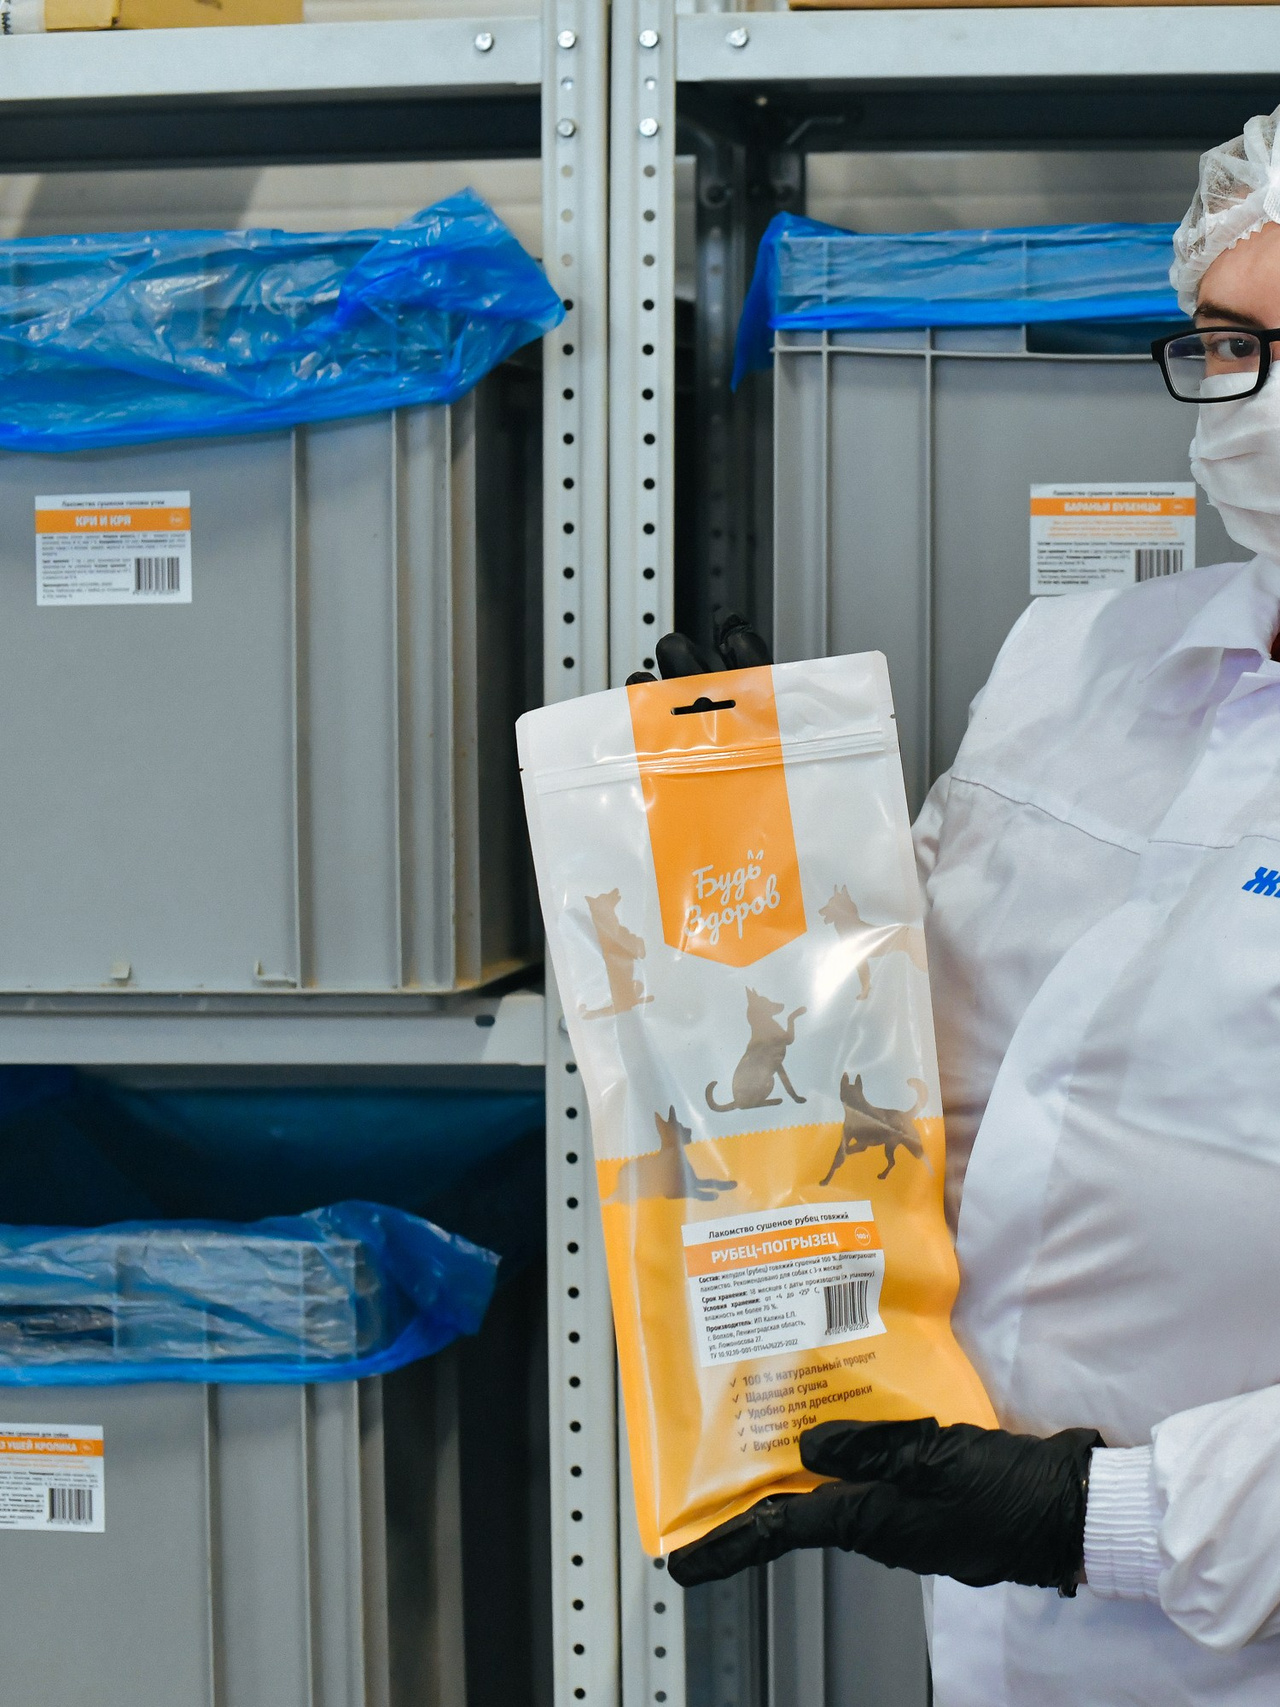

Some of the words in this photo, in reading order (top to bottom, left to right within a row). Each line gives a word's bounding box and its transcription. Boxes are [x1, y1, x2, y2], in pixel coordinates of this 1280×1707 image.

[692, 862, 762, 906] Будь
[684, 873, 781, 945] Здоров
[708, 1225, 755, 1239] Лакомство
[756, 1219, 793, 1232] сушеное
[795, 1215, 820, 1226] рубец
[820, 1211, 850, 1221] говяжий
[711, 1231, 839, 1264] РУБЕЦ-ПОГРЫЗЕЦ
[698, 1275, 720, 1284] Состав:
[721, 1270, 746, 1280] желудок
[746, 1265, 769, 1276] (рубец)
[794, 1257, 820, 1268] сушеный
[791, 1269, 808, 1277] собак
[701, 1296, 717, 1304] Срок
[717, 1289, 748, 1302] хранения:
[702, 1303, 727, 1313] Условия
[730, 1297, 760, 1308] хранения:
[735, 1324, 780, 1337] Ленинградская
[743, 1374, 762, 1387] 100
[763, 1372, 774, 1383] %
[775, 1357, 843, 1381] натуральный
[843, 1350, 877, 1368] продукт
[745, 1386, 795, 1404] Щадящая
[797, 1378, 828, 1395] сушка
[748, 1402, 786, 1419] Удобно
[788, 1400, 807, 1414] для
[809, 1384, 873, 1410] дрессировки
[750, 1421, 789, 1435] Чистые
[791, 1413, 817, 1429] зубы
[753, 1436, 790, 1452] Вкусно
